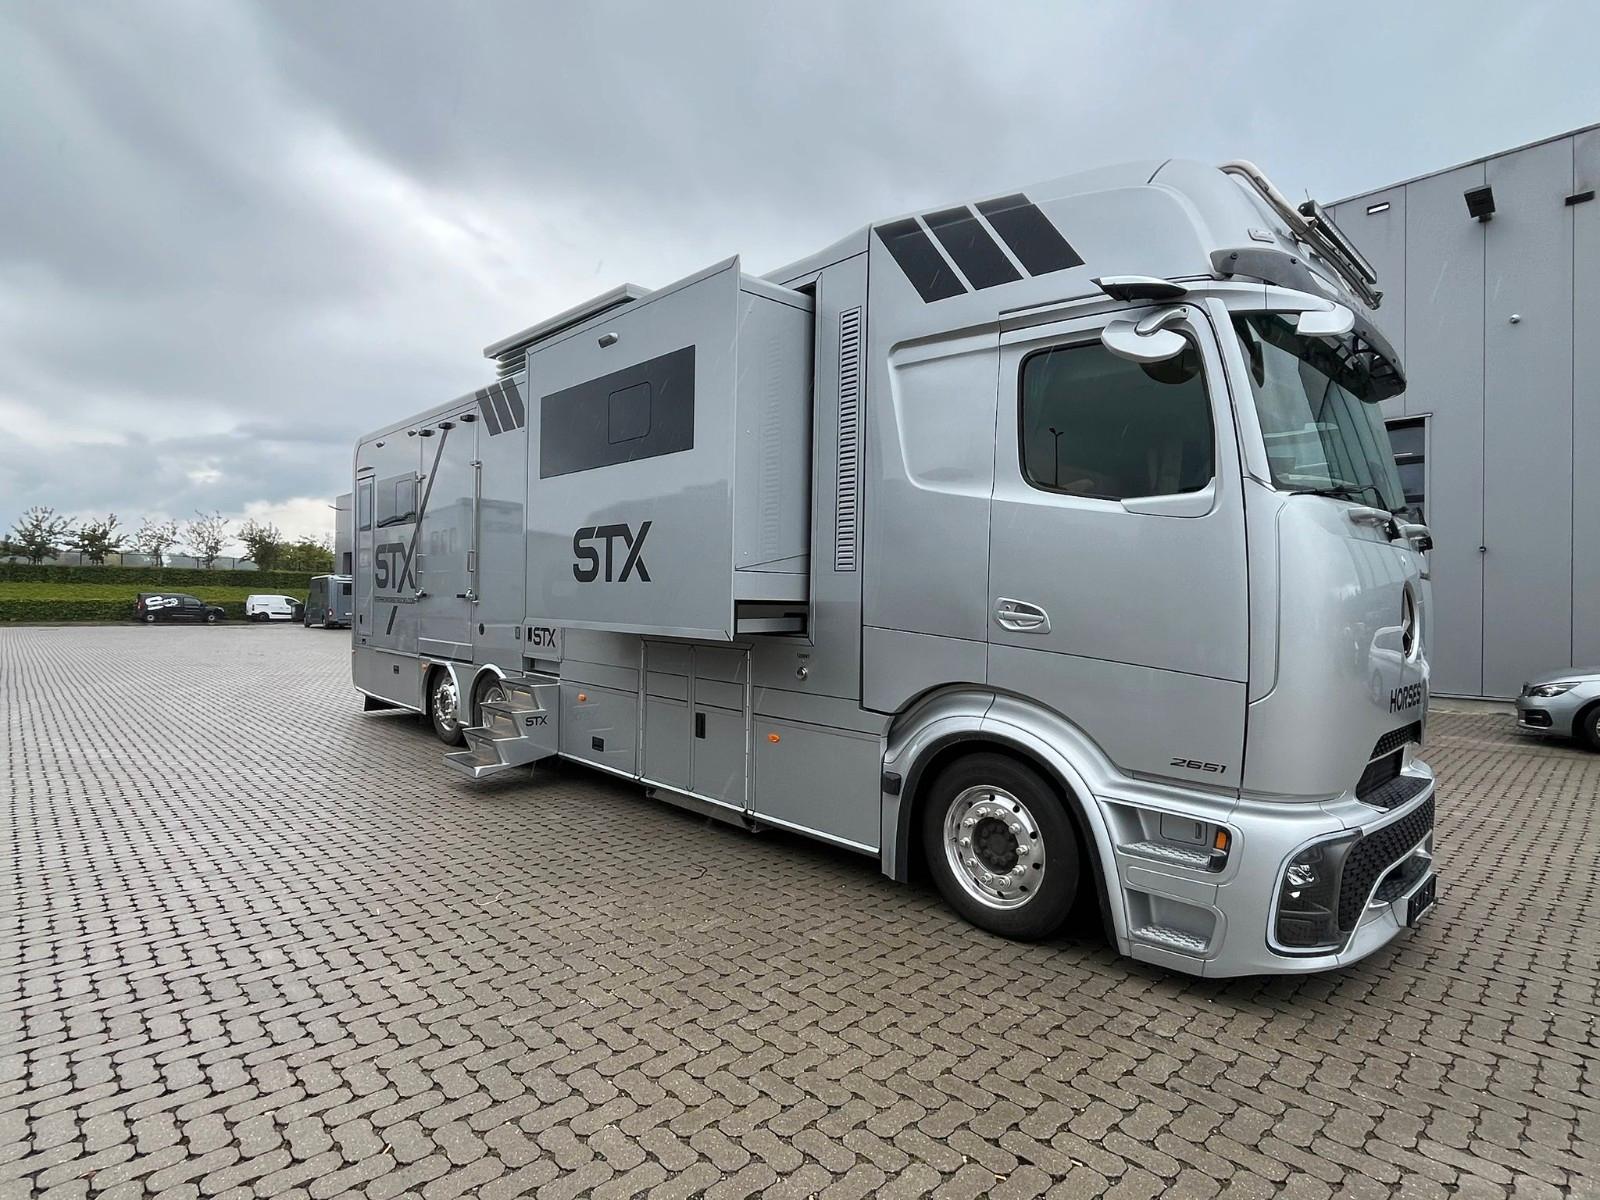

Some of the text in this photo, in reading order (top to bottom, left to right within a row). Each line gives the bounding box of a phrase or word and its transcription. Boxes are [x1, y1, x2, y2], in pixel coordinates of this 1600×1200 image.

[572, 521, 653, 583] STX
[375, 539, 416, 593] STX
[533, 626, 556, 648] STX
[1389, 682, 1421, 714] HORSES
[525, 715, 548, 727] STX
[1170, 757, 1227, 774] 2651
